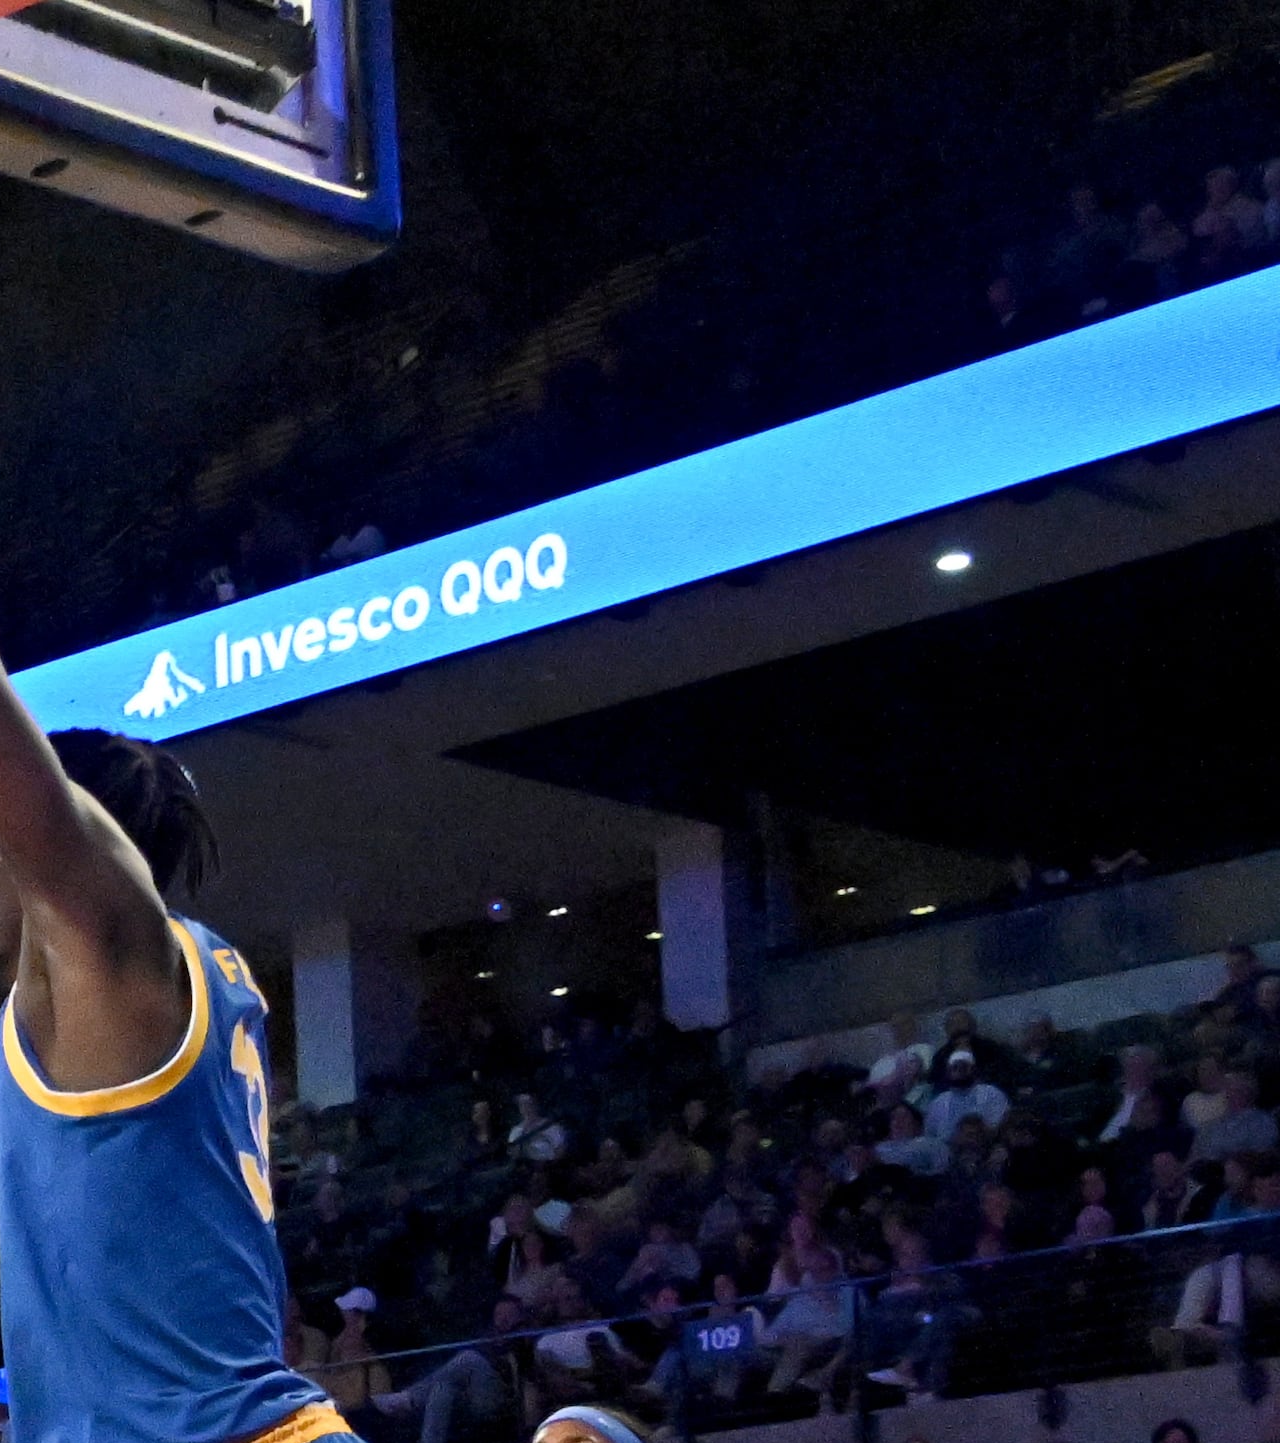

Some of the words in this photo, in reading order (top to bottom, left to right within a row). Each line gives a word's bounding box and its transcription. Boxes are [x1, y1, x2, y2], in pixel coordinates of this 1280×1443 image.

[215, 585, 430, 689] Invesco
[440, 533, 568, 617] QQQ
[697, 1325, 740, 1351] 109
